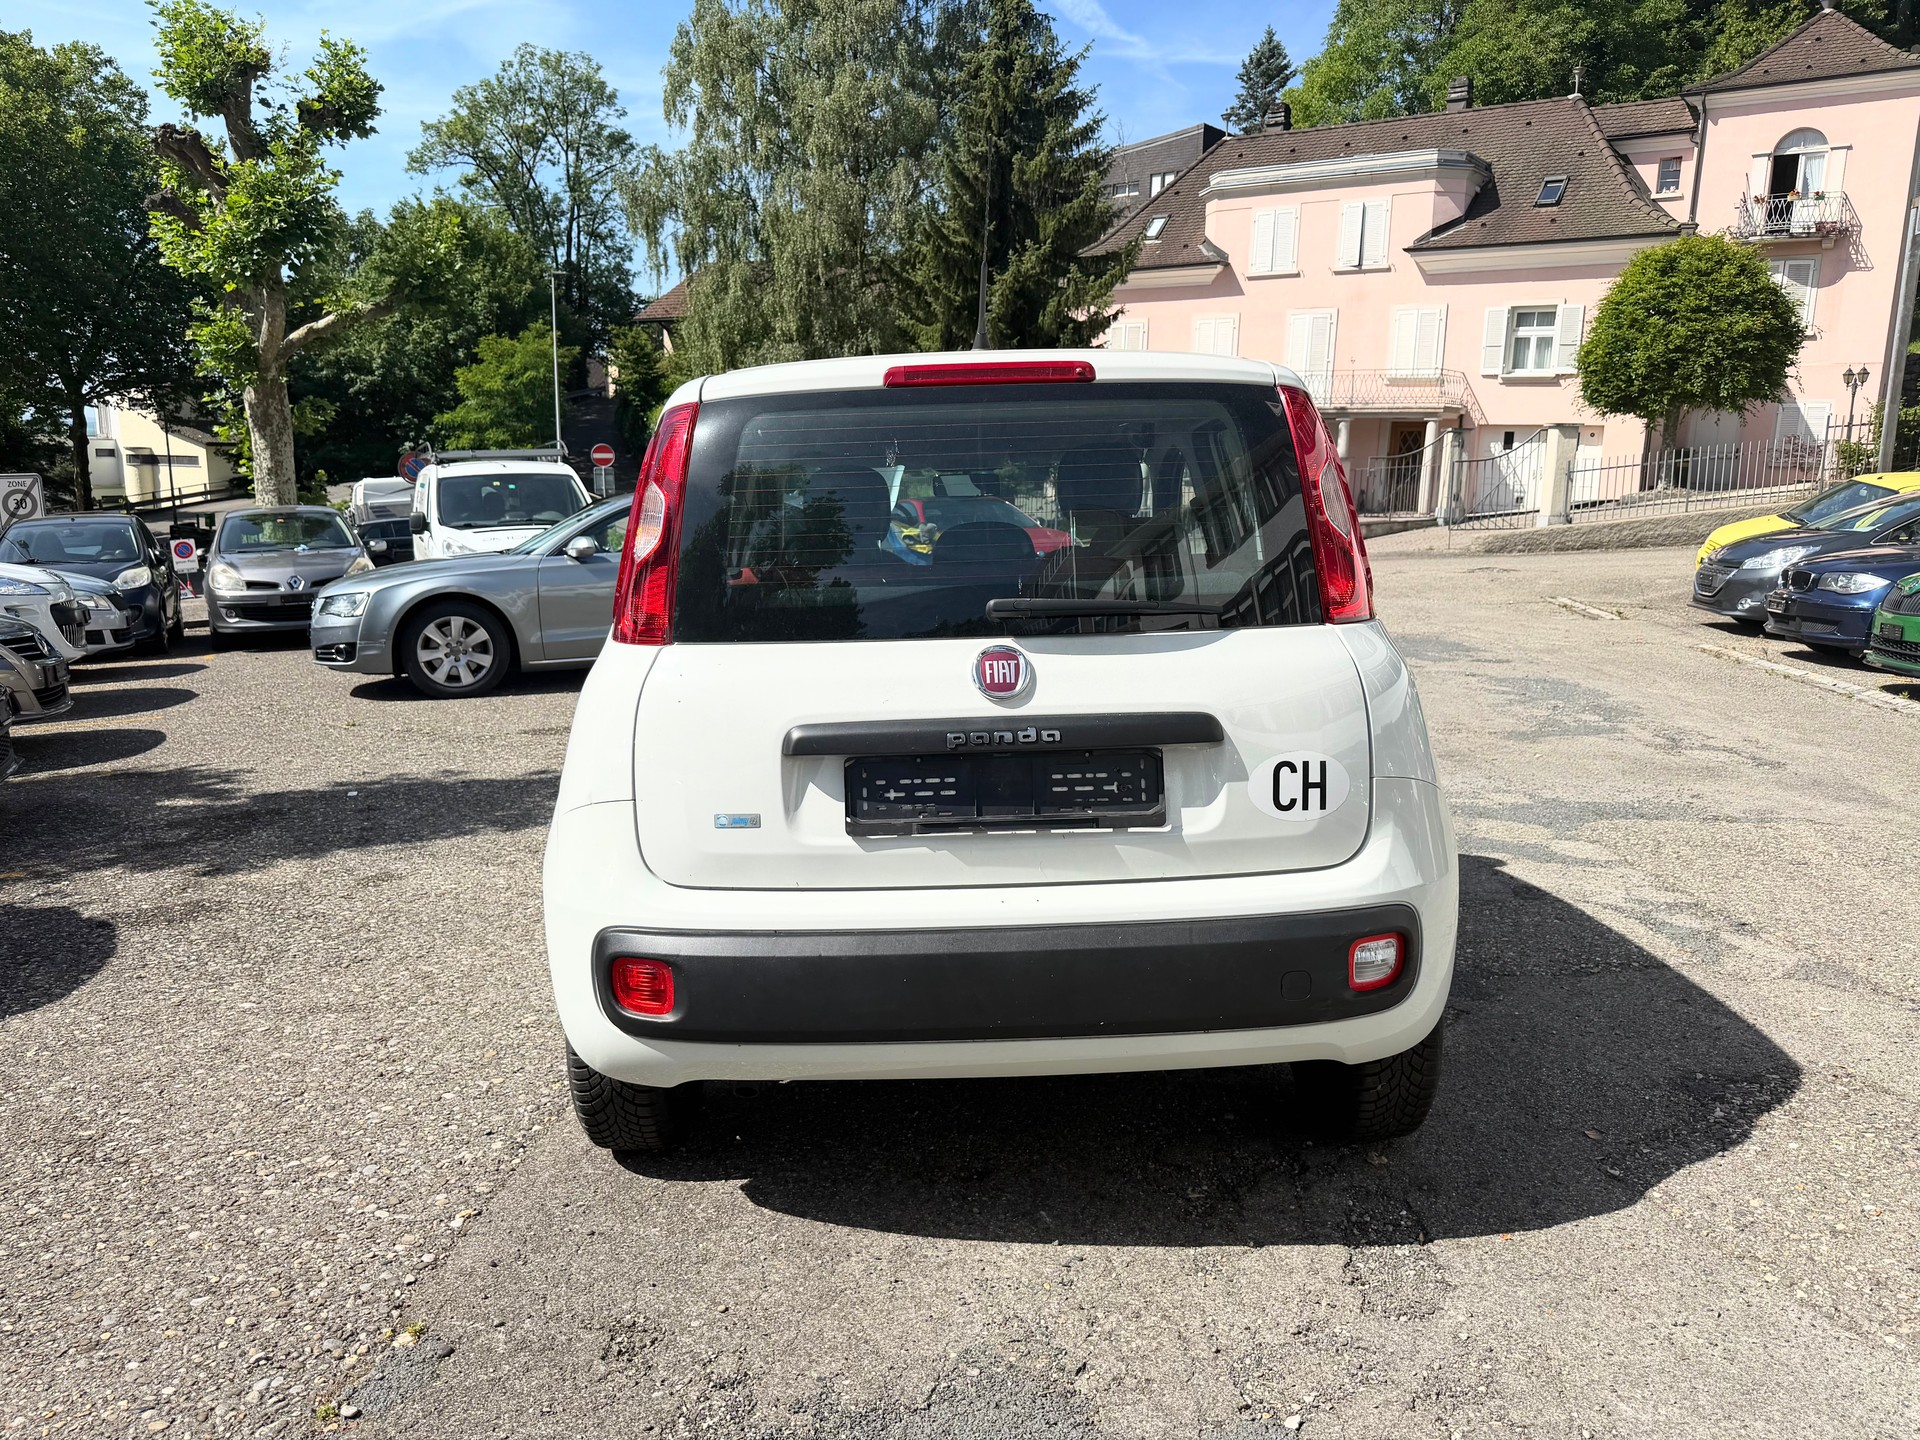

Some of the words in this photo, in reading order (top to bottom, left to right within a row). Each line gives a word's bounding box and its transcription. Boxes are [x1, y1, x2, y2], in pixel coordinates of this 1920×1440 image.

[7, 480, 28, 488] ZONE
[13, 498, 28, 510] 30
[984, 660, 1018, 684] FIAT
[946, 726, 1062, 749] panda
[1272, 760, 1327, 812] CH
